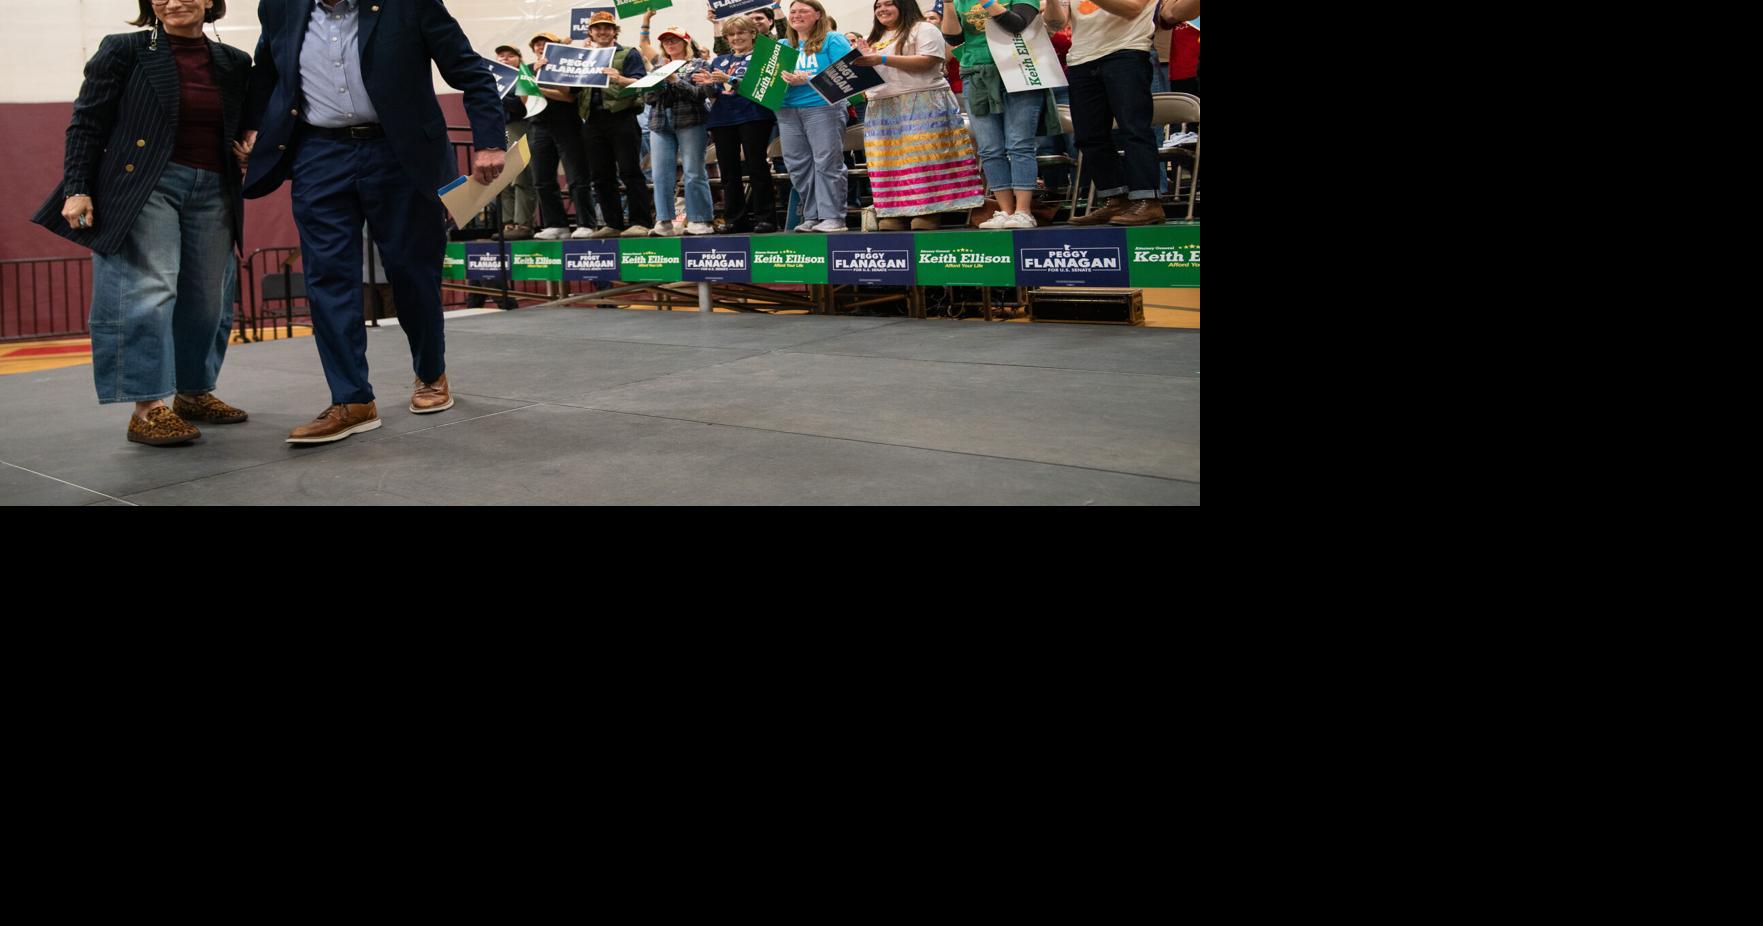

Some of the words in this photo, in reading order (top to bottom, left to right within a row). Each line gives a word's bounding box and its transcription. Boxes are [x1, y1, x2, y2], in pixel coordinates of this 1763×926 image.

[754, 76, 771, 102] Keith
[765, 43, 782, 77] Ellison
[1022, 57, 1042, 86] Keith
[621, 255, 646, 264] Keith
[647, 255, 680, 264] Ellison
[753, 254, 783, 264] Keith
[785, 254, 825, 264] Ellison
[854, 252, 885, 260] PEGGY
[918, 253, 957, 264] Keith
[960, 253, 1011, 264] Ellison
[1133, 250, 1184, 262] Keith
[567, 260, 614, 268] FLANAGAN
[687, 259, 744, 268] FLANAGAN
[835, 259, 906, 268] FLANAGAN
[1024, 258, 1117, 268] FLANAGAN
